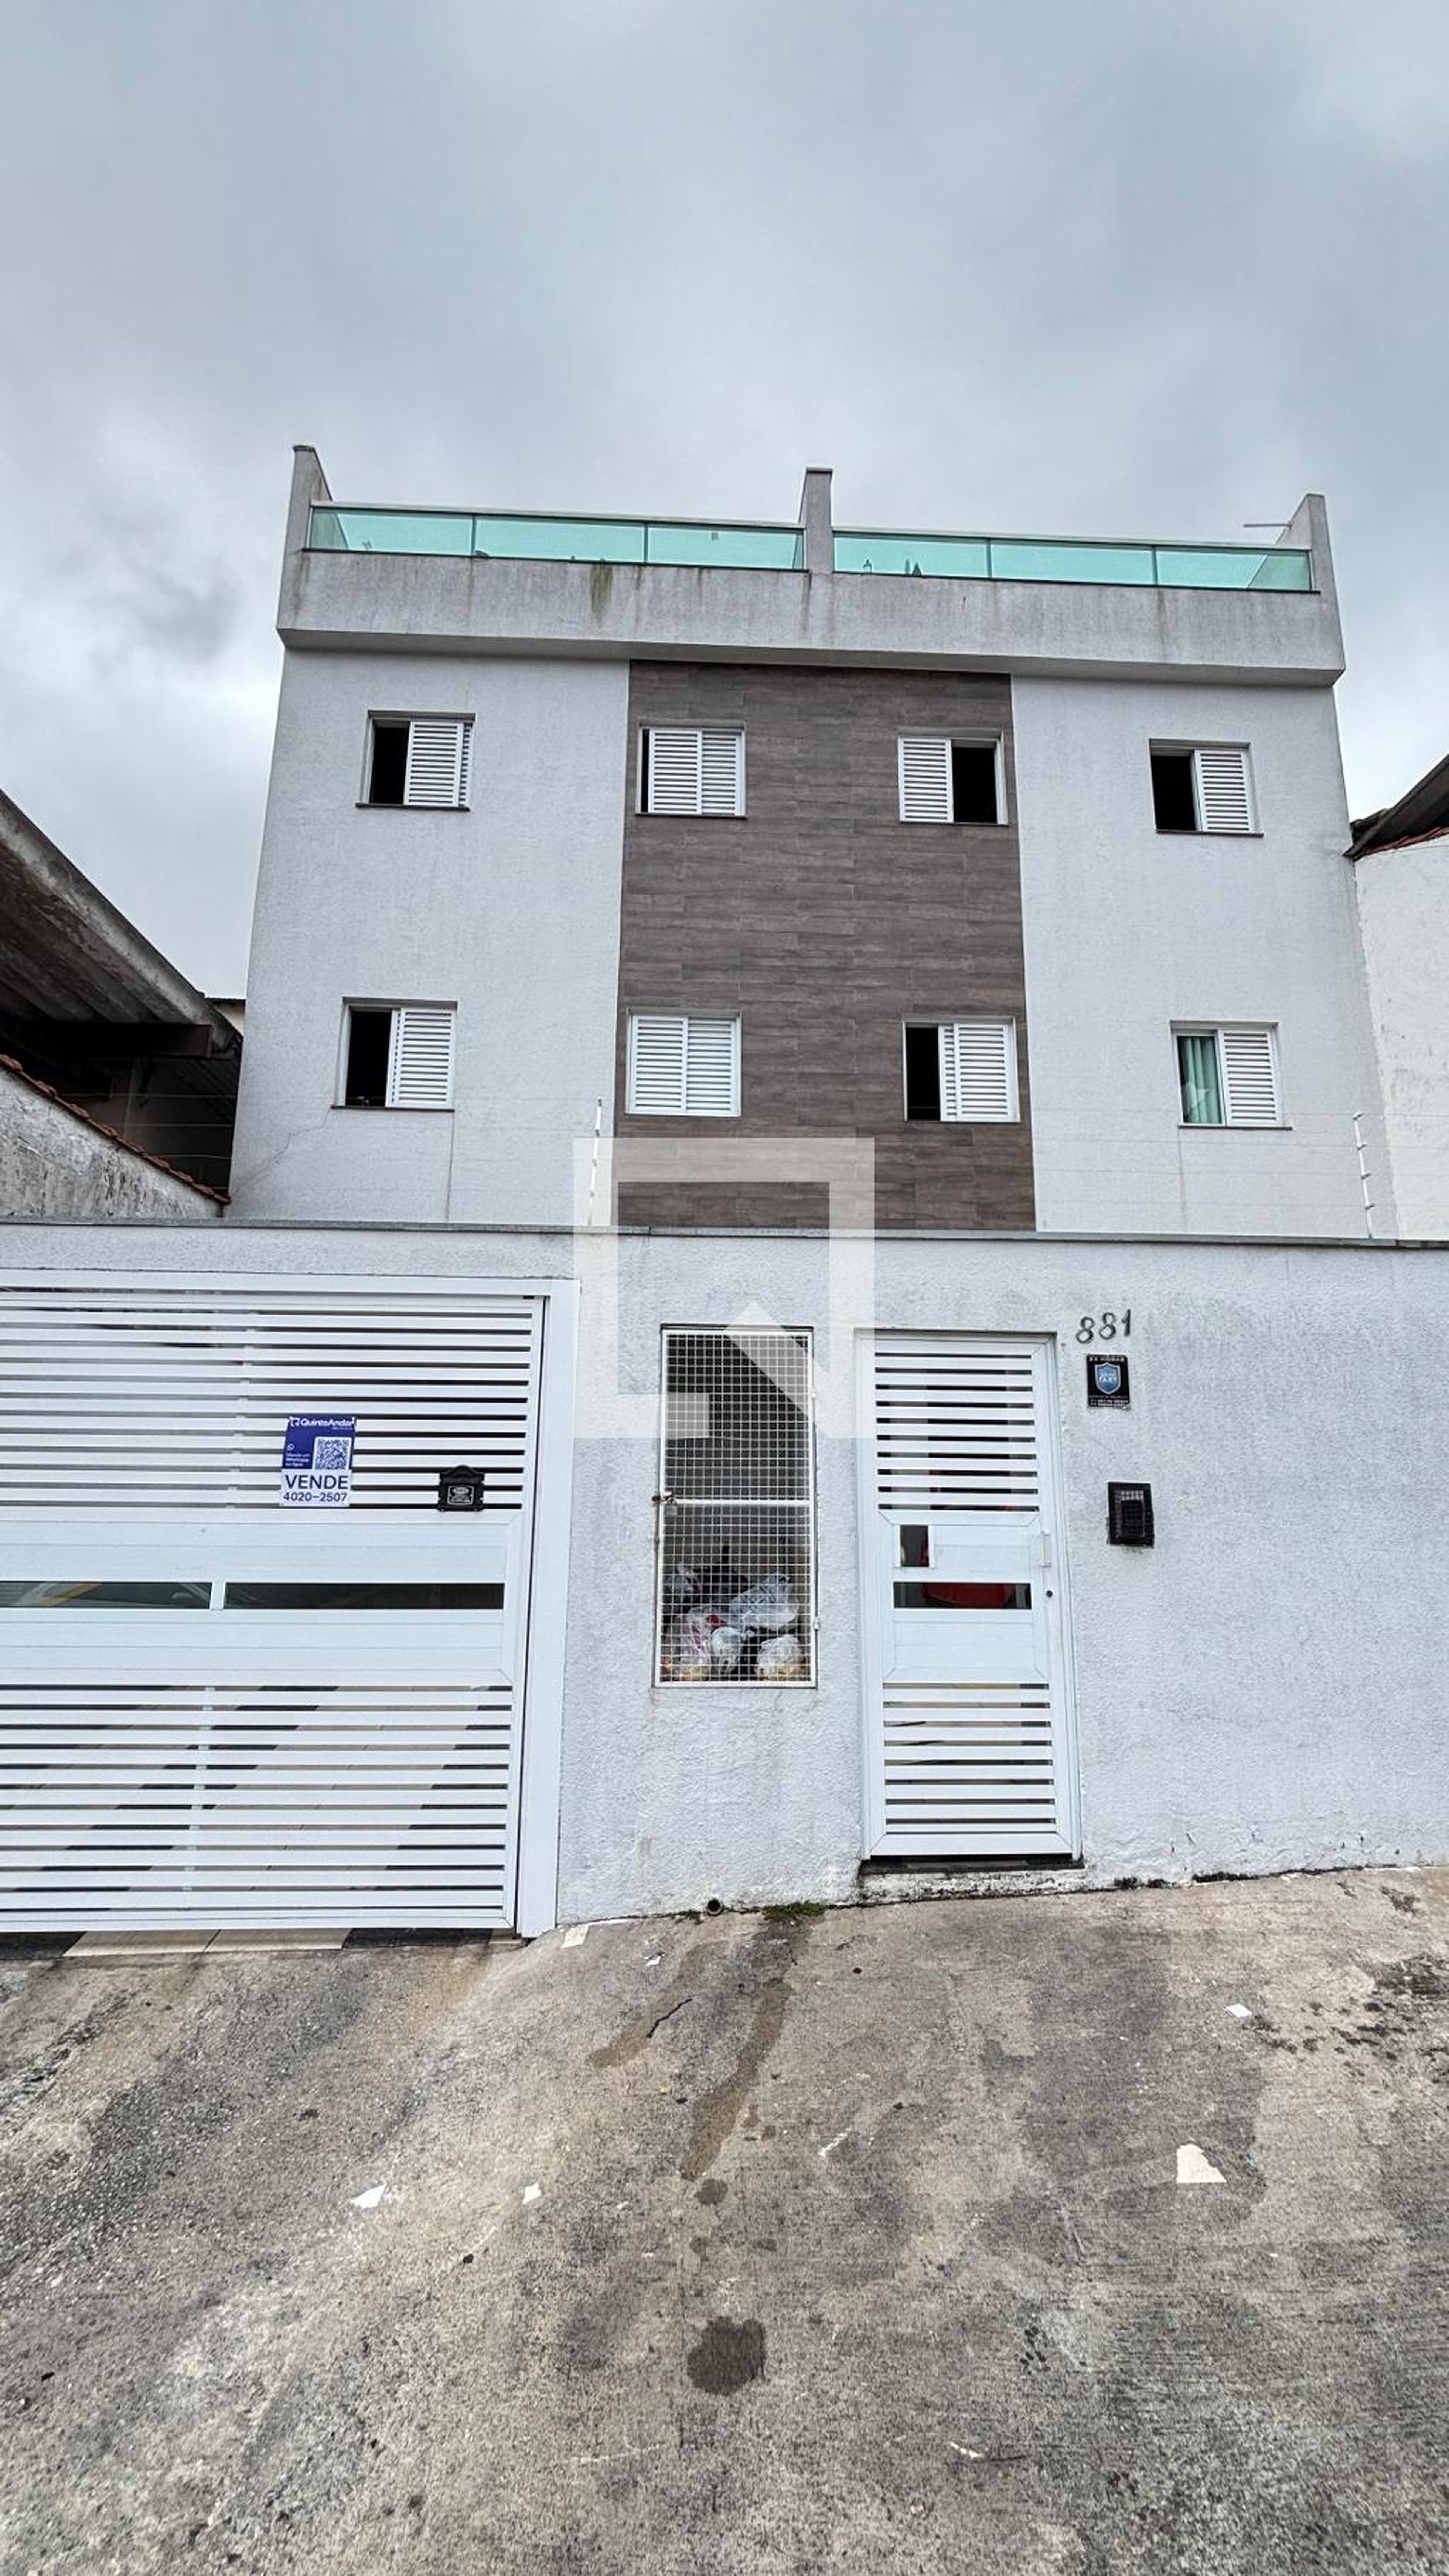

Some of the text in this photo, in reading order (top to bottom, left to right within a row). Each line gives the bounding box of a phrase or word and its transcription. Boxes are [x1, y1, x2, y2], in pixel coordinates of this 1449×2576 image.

[1075, 1309, 1131, 1344] 881
[285, 1475, 348, 1489] VENDE
[283, 1492, 347, 1502] 4020-2507
